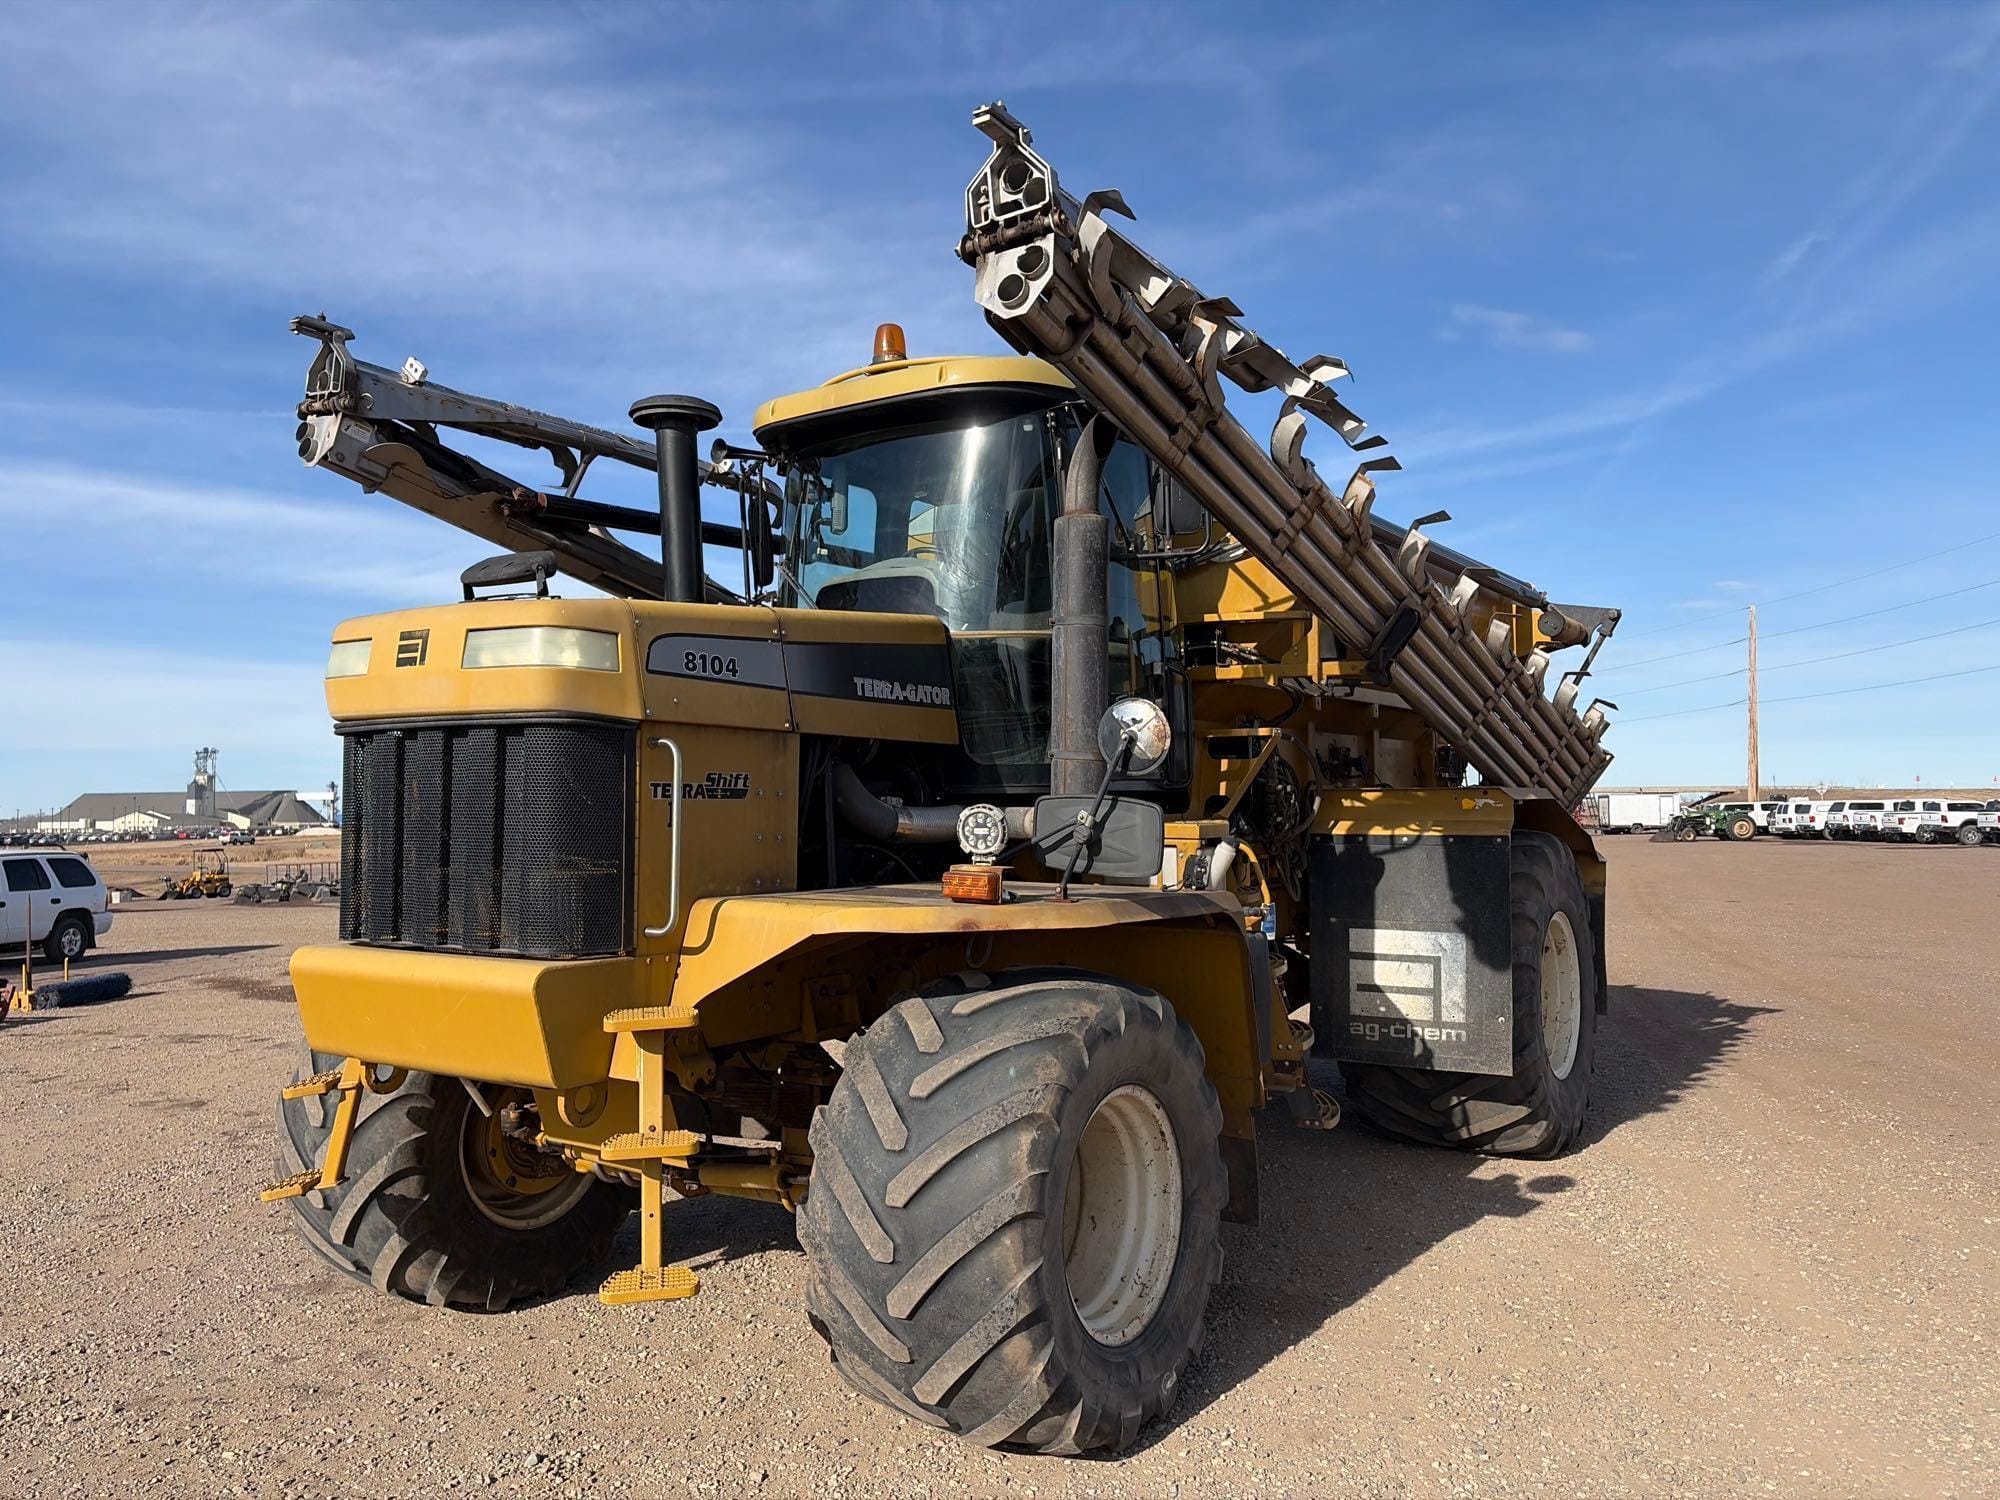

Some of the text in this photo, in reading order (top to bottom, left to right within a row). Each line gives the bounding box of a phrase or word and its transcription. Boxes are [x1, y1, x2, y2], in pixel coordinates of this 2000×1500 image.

[683, 650, 739, 678] 8104
[853, 676, 950, 705] TERRA-GATOR
[650, 772, 750, 800] TERA Shift
[1349, 1022, 1467, 1041] ag-chem
